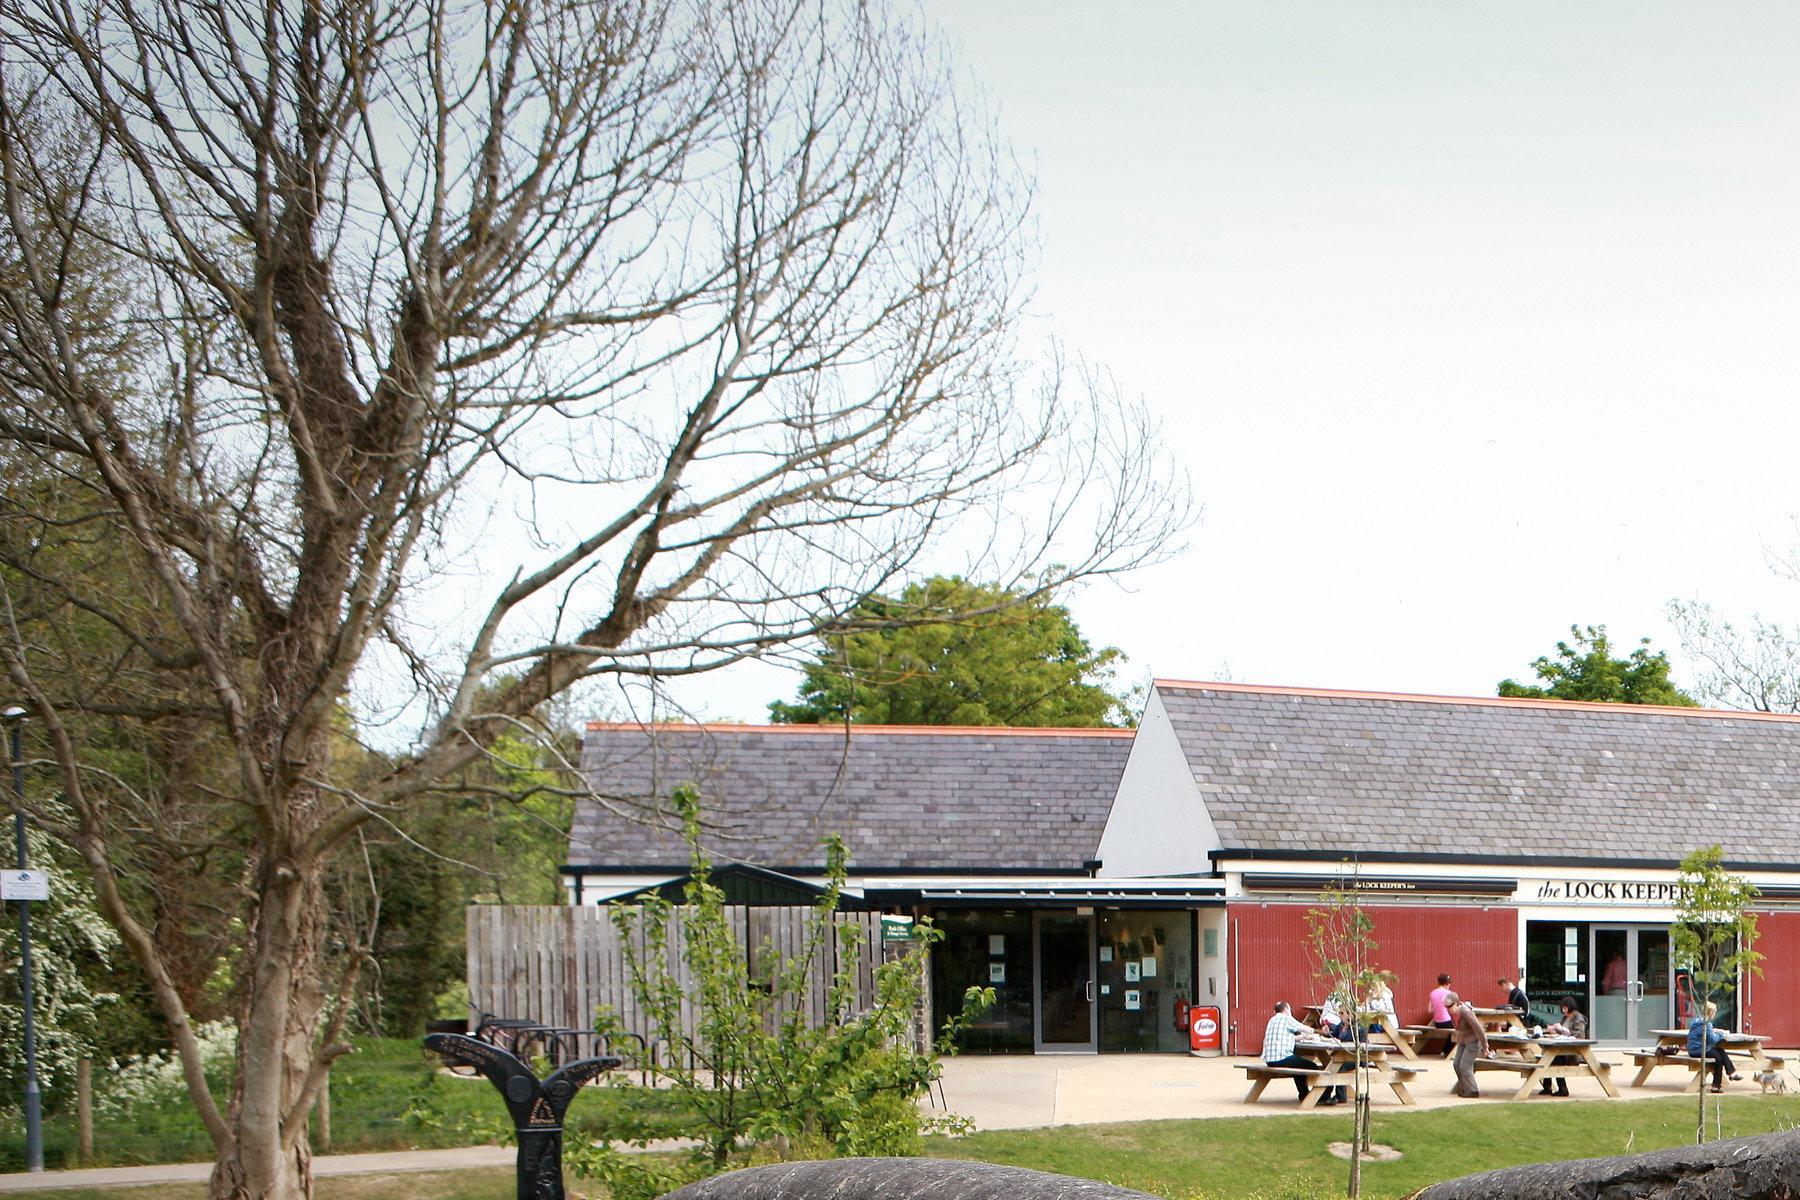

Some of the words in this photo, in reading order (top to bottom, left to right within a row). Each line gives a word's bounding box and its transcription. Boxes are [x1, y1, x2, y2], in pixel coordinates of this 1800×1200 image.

[1537, 881, 1561, 899] the
[1565, 881, 1618, 899] LOCK
[1621, 882, 1692, 900] KEEPER
